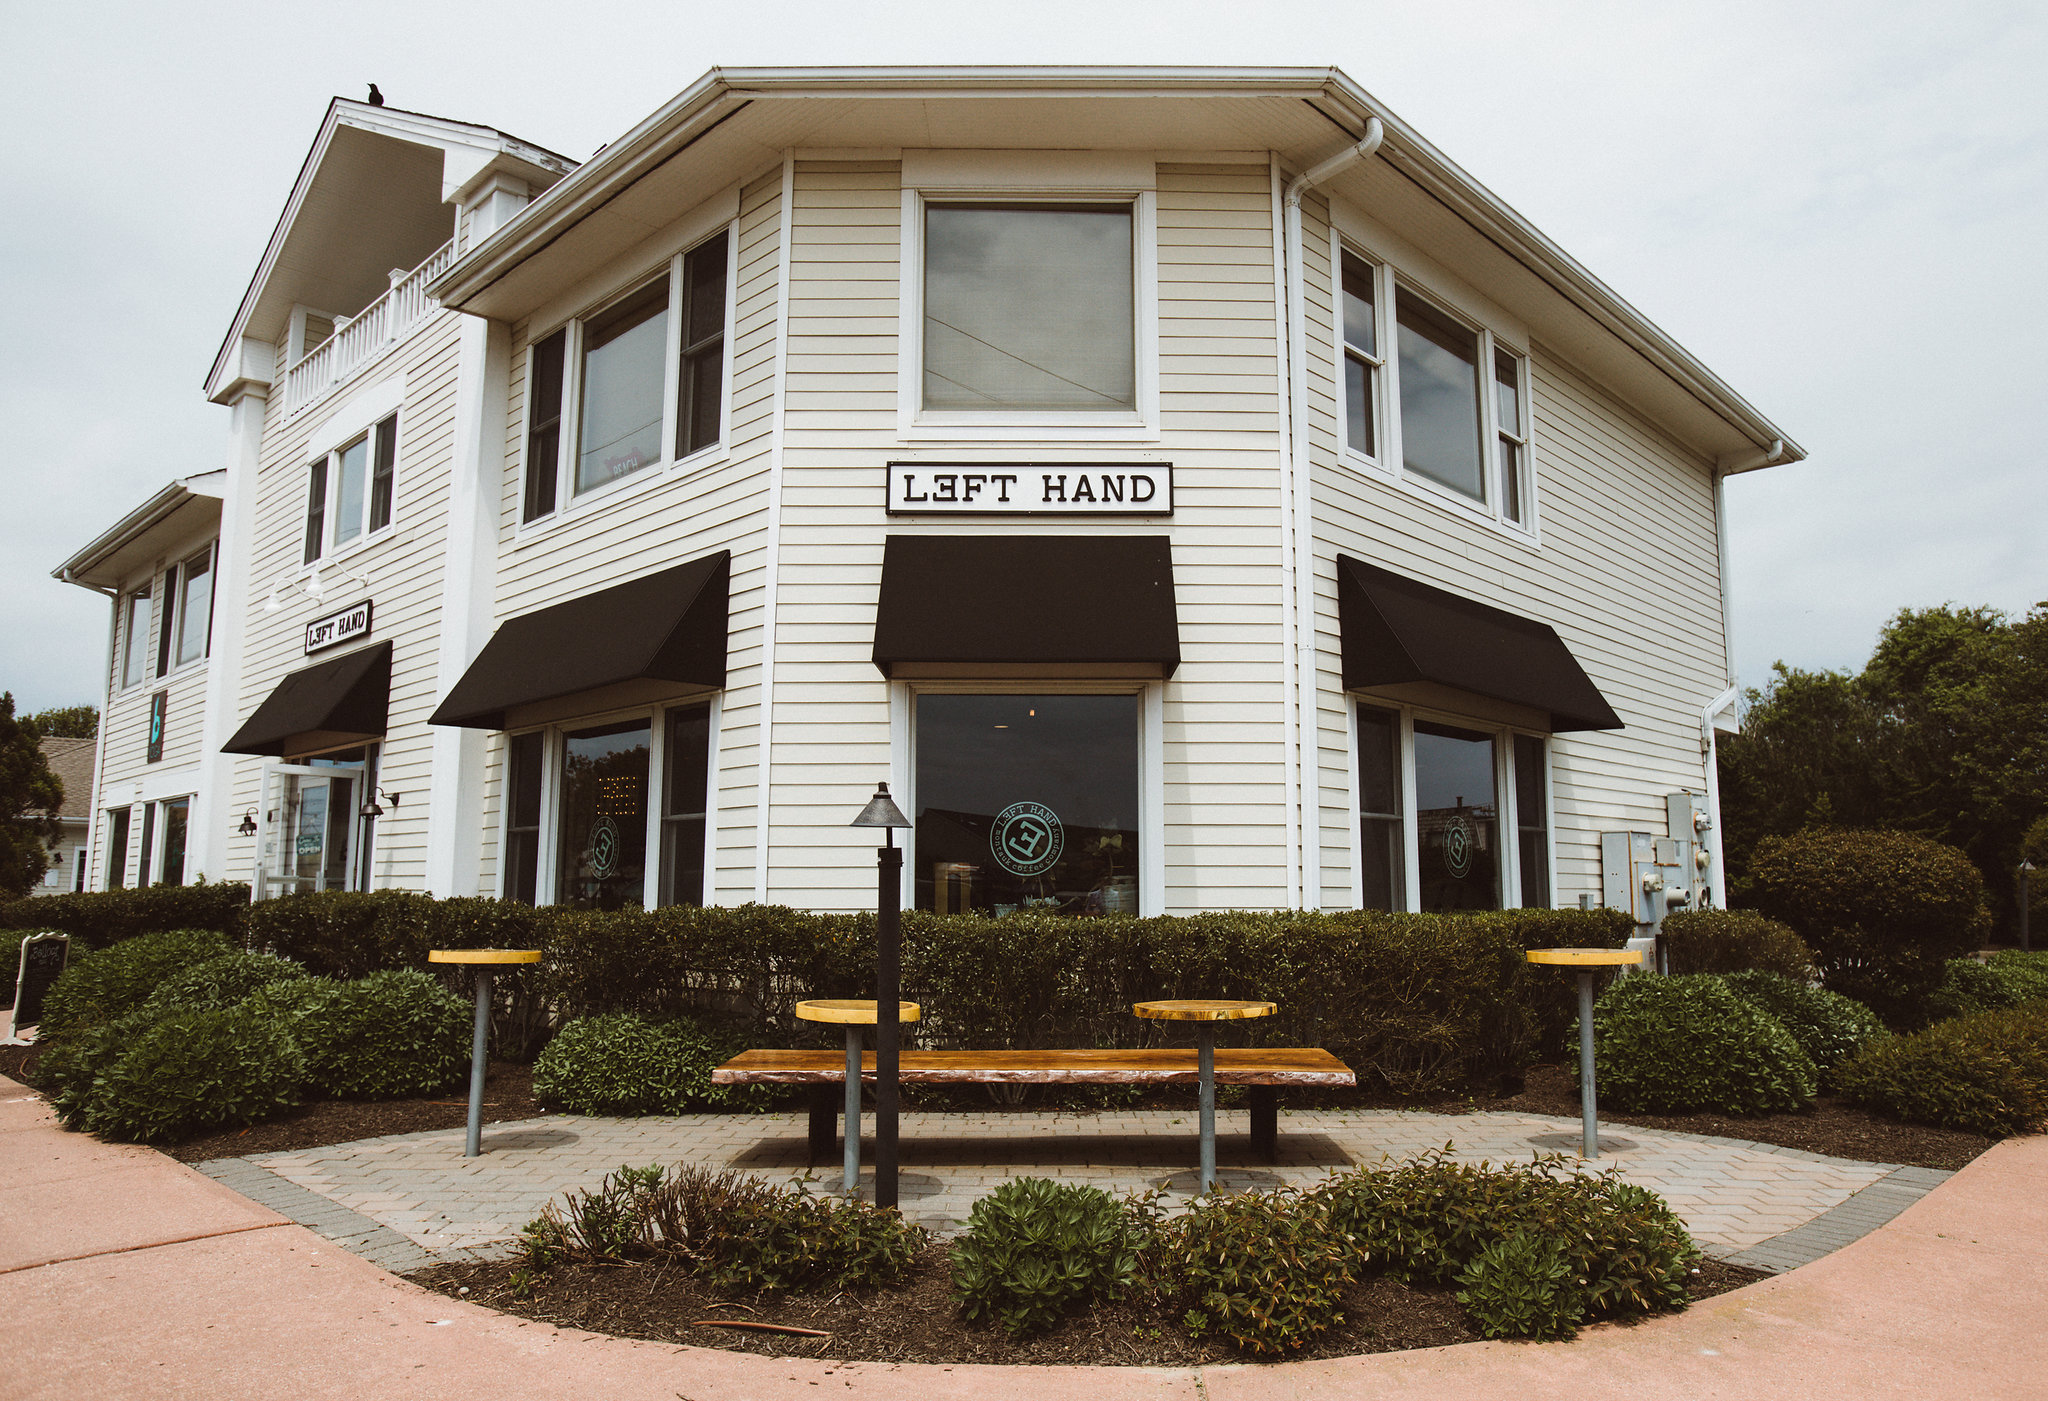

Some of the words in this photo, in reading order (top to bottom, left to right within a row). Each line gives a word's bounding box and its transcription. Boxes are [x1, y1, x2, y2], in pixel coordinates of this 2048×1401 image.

[1042, 474, 1156, 502] HAND
[338, 610, 365, 636] HAND
[1030, 805, 1057, 827] HAND
[298, 845, 321, 855] OPEN
[1012, 863, 1045, 872] coffee
